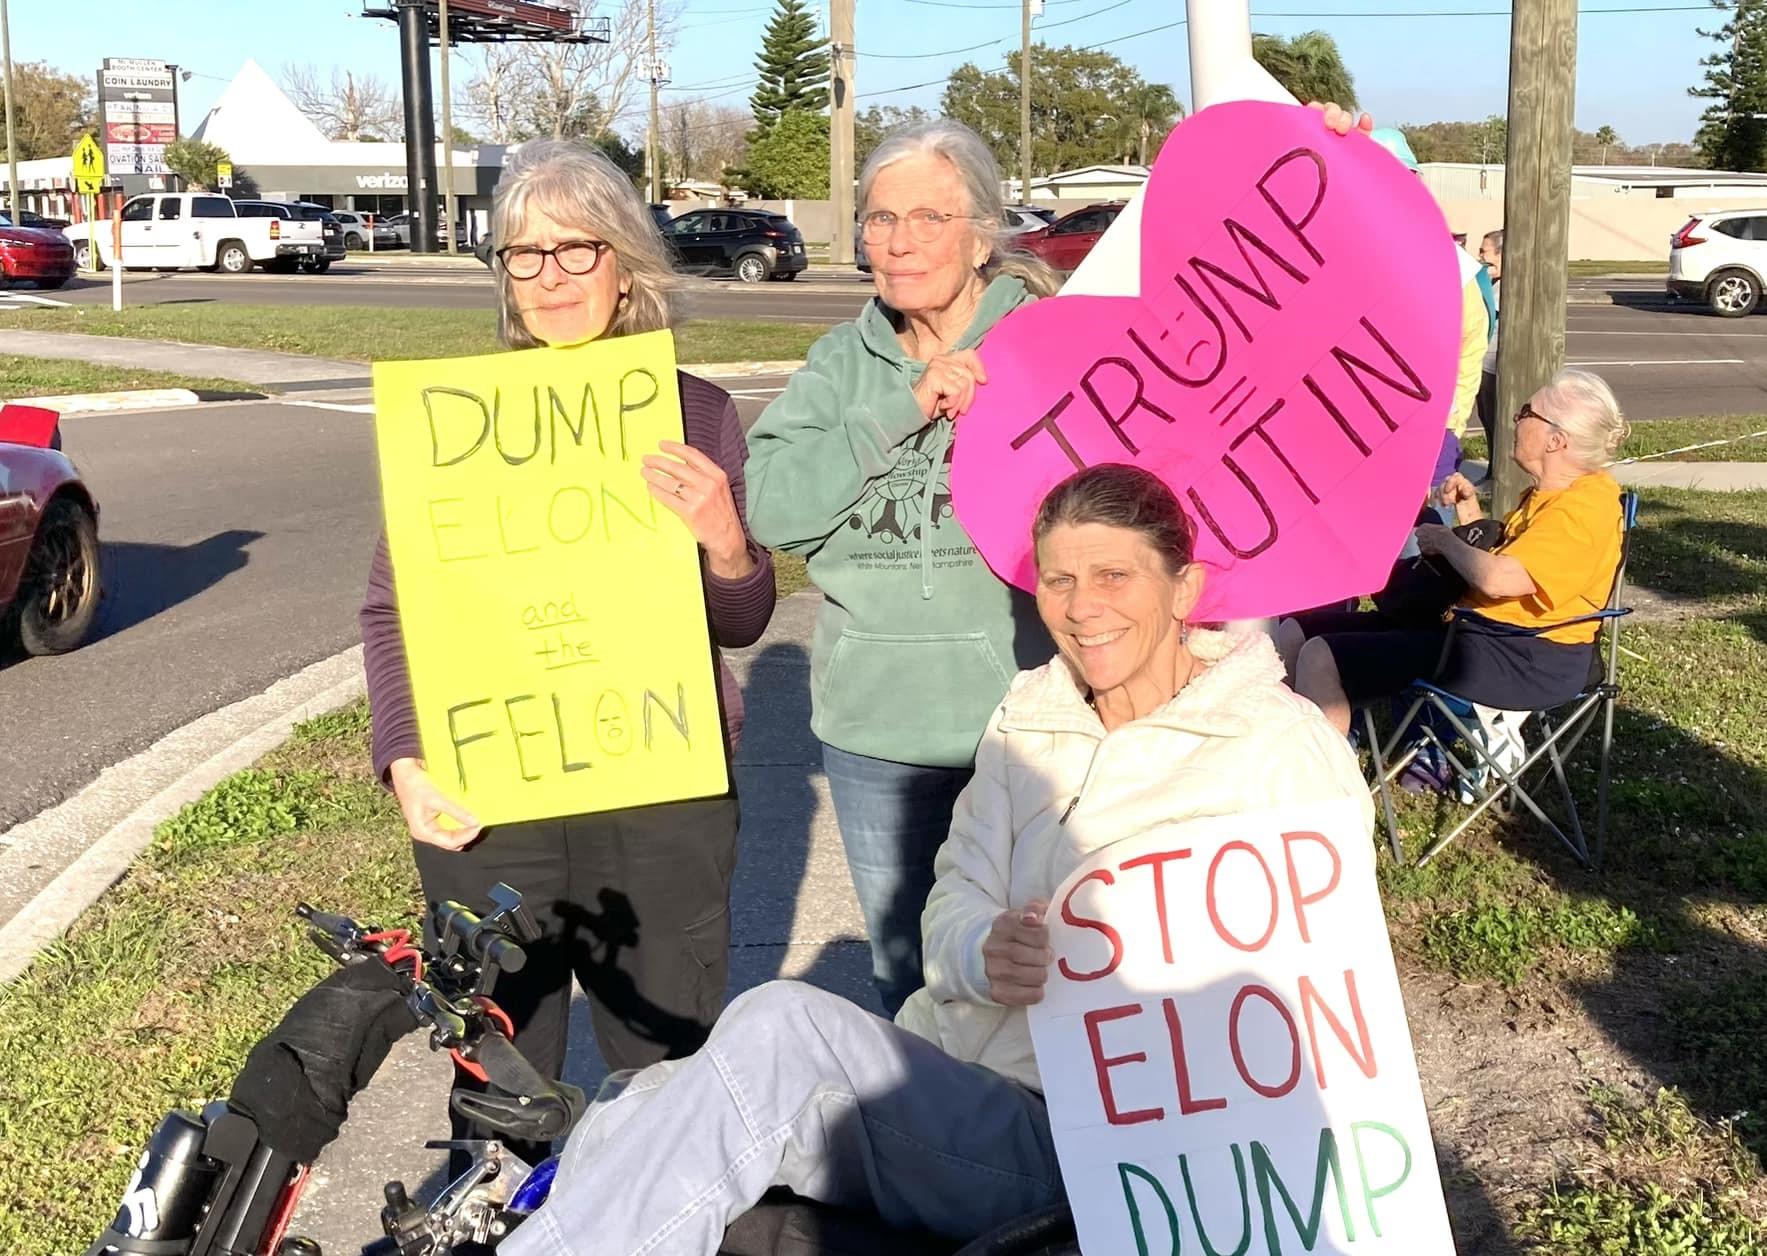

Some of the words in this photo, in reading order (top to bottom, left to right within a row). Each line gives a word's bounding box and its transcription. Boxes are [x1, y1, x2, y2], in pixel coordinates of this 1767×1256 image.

[104, 77, 127, 85] COIN
[130, 79, 171, 87] LAUNDRY
[356, 172, 408, 188] verizo
[1010, 147, 1328, 470] TRUMP
[421, 368, 660, 467] DUMP
[1186, 316, 1432, 560] UTIN
[428, 480, 658, 563] ELON
[521, 592, 582, 626] and
[534, 632, 593, 665] the
[447, 682, 691, 793] FELON
[1057, 831, 1342, 982] STOP
[1083, 969, 1378, 1125] ELON
[1117, 1120, 1412, 1256] DUMP
